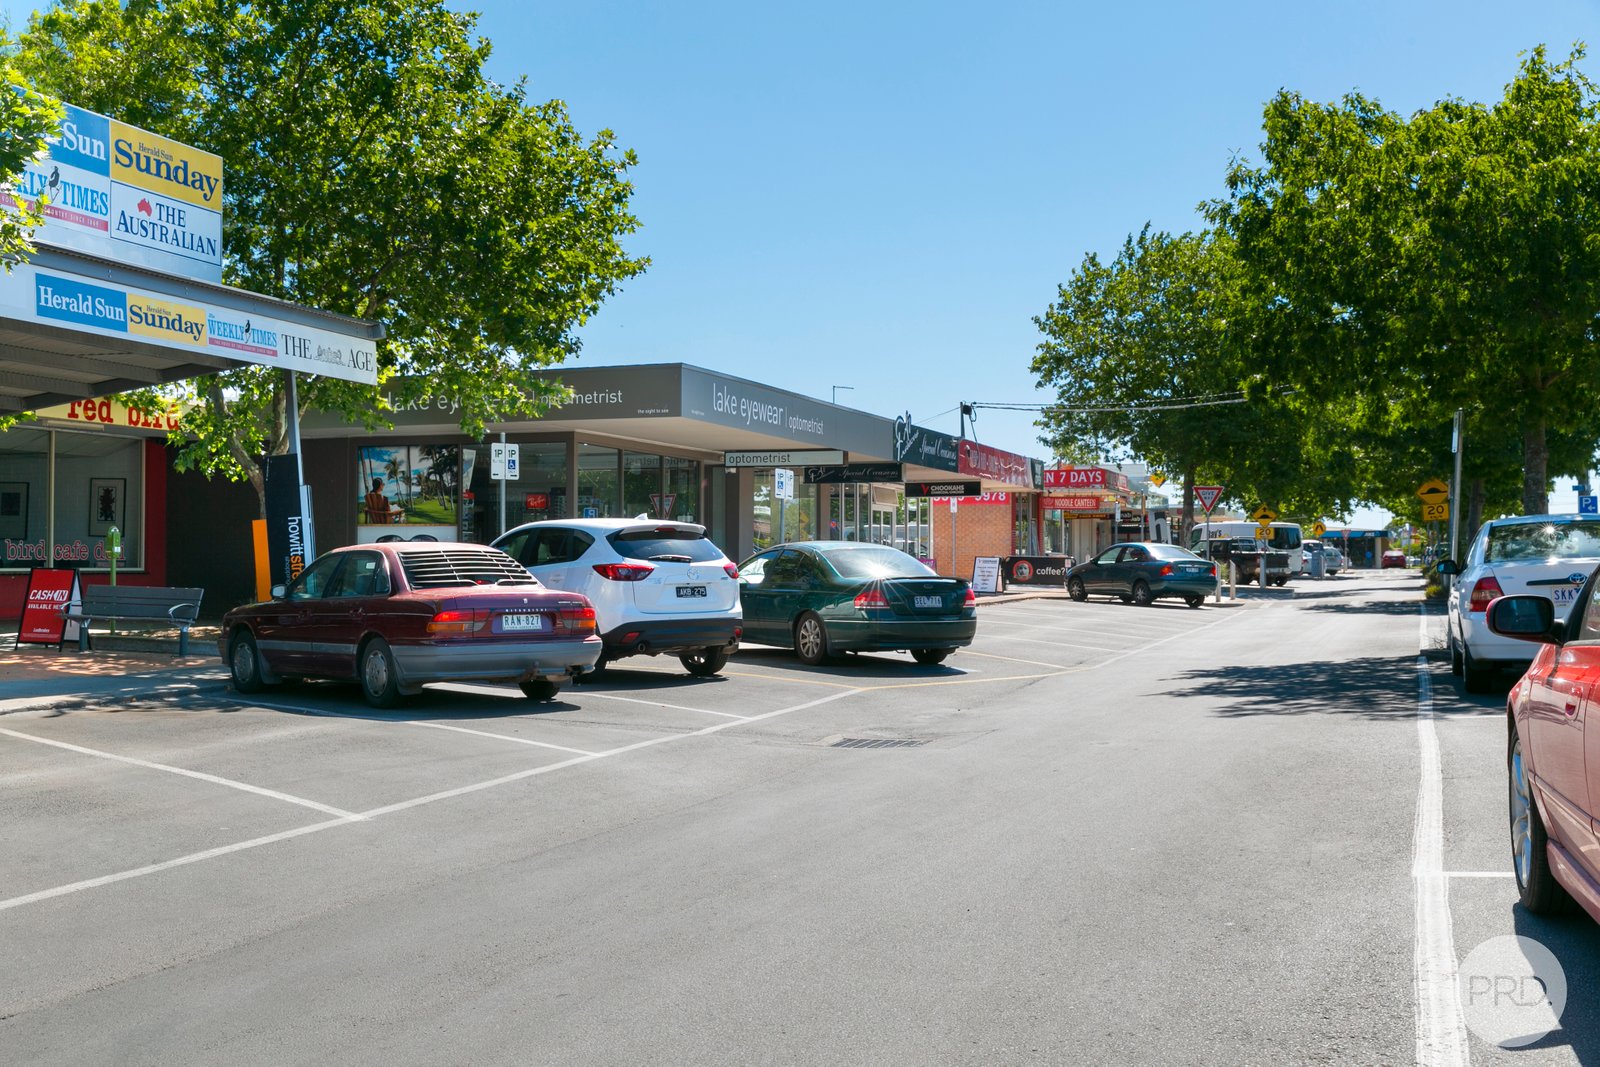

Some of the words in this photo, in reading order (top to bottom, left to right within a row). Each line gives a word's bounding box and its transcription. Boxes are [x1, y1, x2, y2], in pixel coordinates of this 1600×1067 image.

[62, 121, 106, 160] Sun
[138, 142, 160, 158] Herald
[114, 138, 219, 202] Sunday
[60, 180, 109, 217] TIMES
[156, 203, 186, 228] THE
[116, 210, 217, 257] AUSTRALIAN
[38, 285, 93, 315] Herald
[95, 297, 125, 321] Sun
[129, 304, 205, 341] Sunday
[207, 319, 245, 341] WEEKLY
[251, 327, 277, 348] TIMES
[281, 333, 312, 360] THE
[347, 348, 374, 372] AGE
[67, 399, 114, 424] red
[713, 382, 737, 415] lake
[740, 397, 783, 425] eyewear
[788, 415, 824, 435] optometrist
[494, 449, 503, 458] 1P
[508, 449, 516, 458] 1P
[729, 452, 791, 465] optometrist
[1060, 472, 1066, 482] 7
[1070, 471, 1102, 483] DAYS
[1055, 498, 1073, 507] NOODLE
[1074, 498, 1096, 507] CANTEEN
[1427, 505, 1445, 515] 20
[1582, 497, 1591, 508] P
[1259, 528, 1271, 536] 20
[5, 539, 47, 560] bird
[53, 541, 89, 561] cafe
[93, 541, 126, 561] di
[29, 589, 54, 600] CASH
[504, 615, 539, 626] RAN-827
